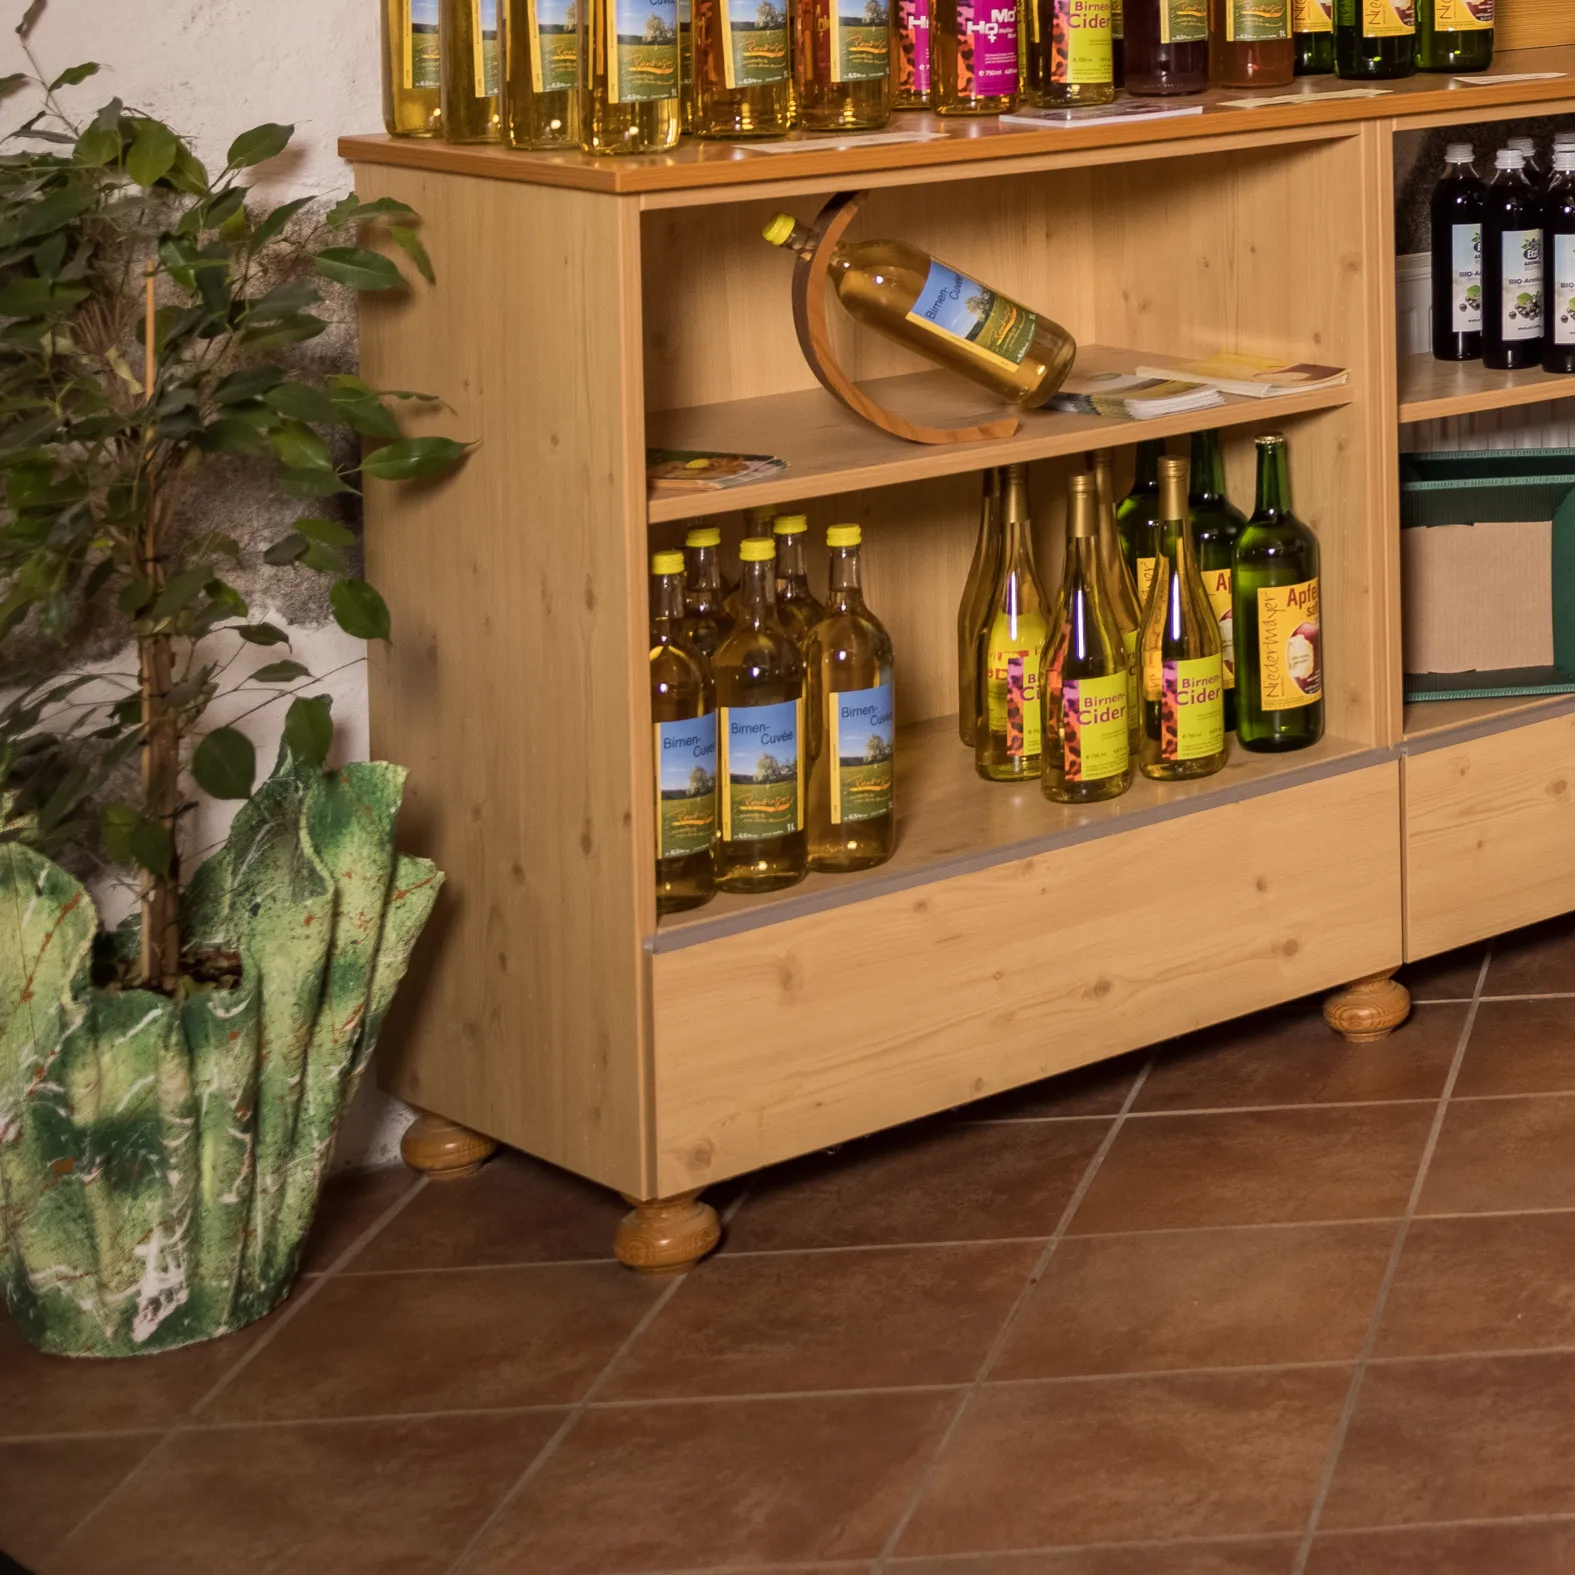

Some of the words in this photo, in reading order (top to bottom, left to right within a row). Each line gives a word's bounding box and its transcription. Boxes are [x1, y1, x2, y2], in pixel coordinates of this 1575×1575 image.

[1067, 13, 1110, 29] Cider
[1181, 675, 1222, 690] Birnen-
[1083, 693, 1126, 709] Birnen-
[1174, 688, 1221, 708] Cider
[1076, 706, 1128, 727] Cider
[730, 721, 771, 737] Birnen-
[760, 729, 795, 746] Cuvée
